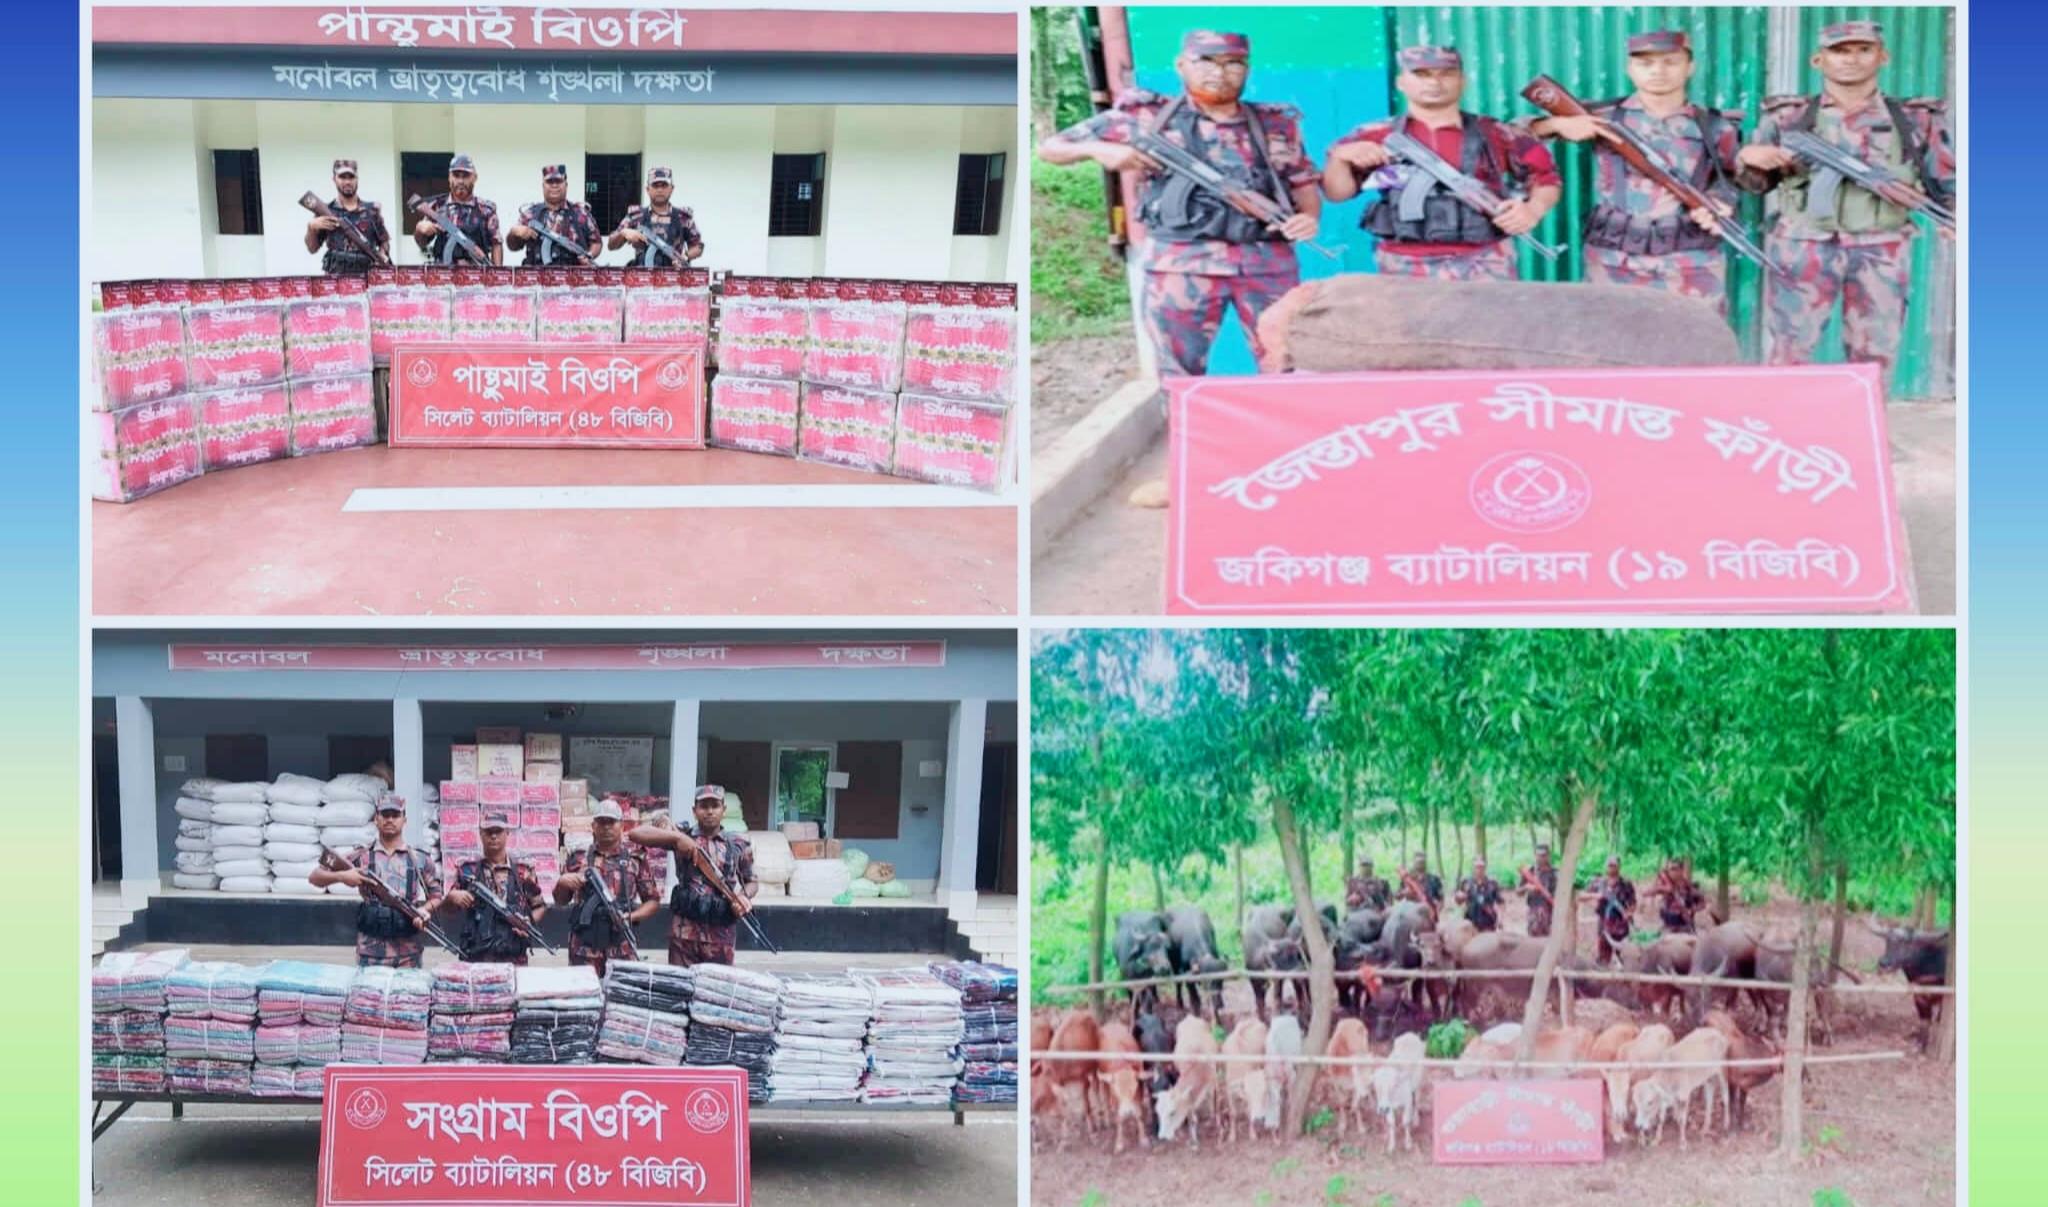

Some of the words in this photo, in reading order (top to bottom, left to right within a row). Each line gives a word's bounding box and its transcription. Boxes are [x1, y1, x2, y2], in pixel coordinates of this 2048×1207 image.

[531, 8, 688, 48] বিওপি
[273, 61, 377, 91] মনোবল
[388, 62, 527, 99] ভ্রাতৃত্ববোধ
[536, 62, 624, 102] শৃঙ্খলা
[632, 64, 716, 94] দক্ষতা
[559, 357, 642, 395] বিওপি
[424, 405, 475, 429] সিলেট
[481, 405, 563, 430] ব্যাটালিয়ন
[568, 409, 604, 432] (৪৮
[610, 406, 673, 432] বিজিবি)
[1208, 401, 1464, 511] জৈন্তাপুর
[1480, 382, 1684, 441] সীমান্ত
[1704, 417, 1857, 503] ফাঁড়ী
[1215, 545, 1371, 587] জকিগঞ্জ
[1385, 542, 1592, 586] ব্যাটালিয়ন
[1607, 547, 1688, 590] (১৯
[1701, 540, 1861, 588] বিজিবি)
[201, 648, 312, 664] মনোবল
[817, 645, 912, 663] দক্ষতা
[403, 1097, 533, 1142] সংগ্রাম
[542, 1089, 668, 1142] বিওপি
[364, 1155, 437, 1188] সিলেট
[443, 1155, 557, 1188] ব্যাটালিয়ন
[565, 1160, 612, 1194] (৪৮
[620, 1155, 707, 1196] বিজিবি)
